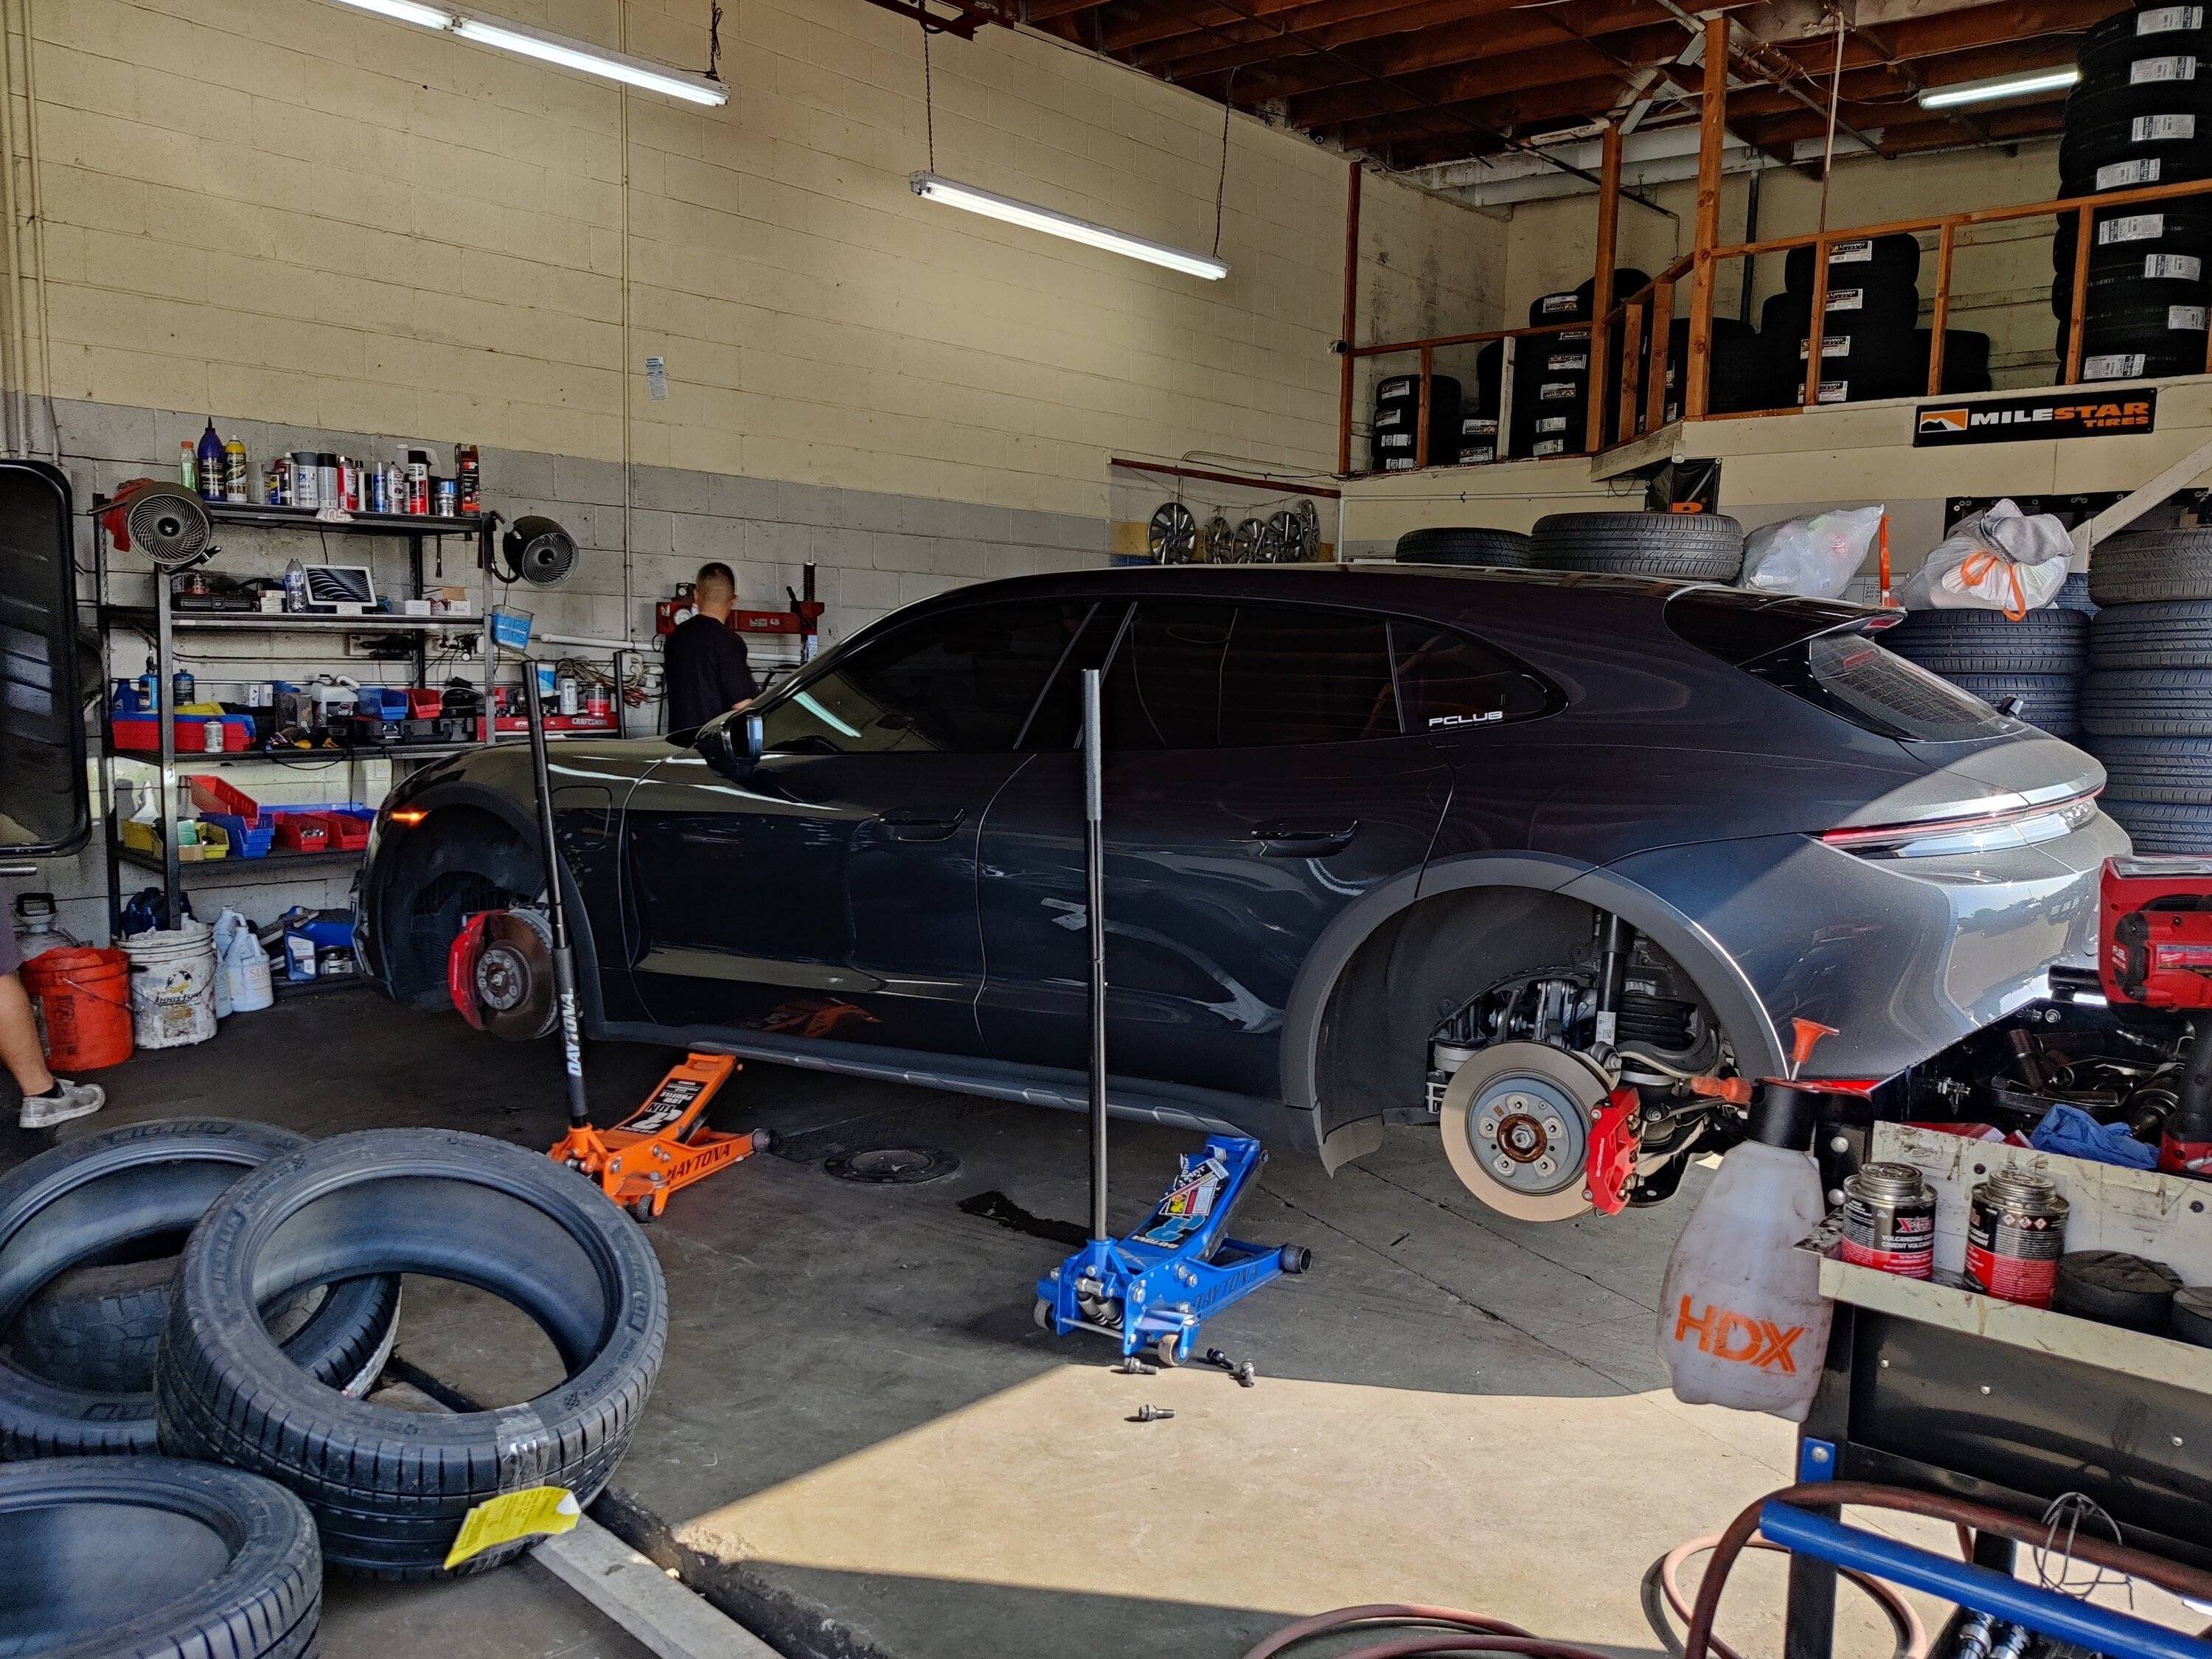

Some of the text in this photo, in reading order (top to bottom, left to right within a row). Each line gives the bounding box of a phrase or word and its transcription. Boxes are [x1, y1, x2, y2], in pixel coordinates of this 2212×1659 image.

[1970, 402, 2149, 425] MILESTAR
[2084, 417, 2149, 428] TIRES
[1428, 711, 1503, 726] PCLUB
[560, 994, 582, 1077] DAYTONA
[631, 1109, 684, 1129] 2
[647, 1102, 677, 1113] TON
[667, 1144, 731, 1181] DAYTONA
[1144, 1214, 1206, 1242] 3
[1193, 1265, 1258, 1311] DAYTONA
[1674, 1293, 1806, 1377] HDX
